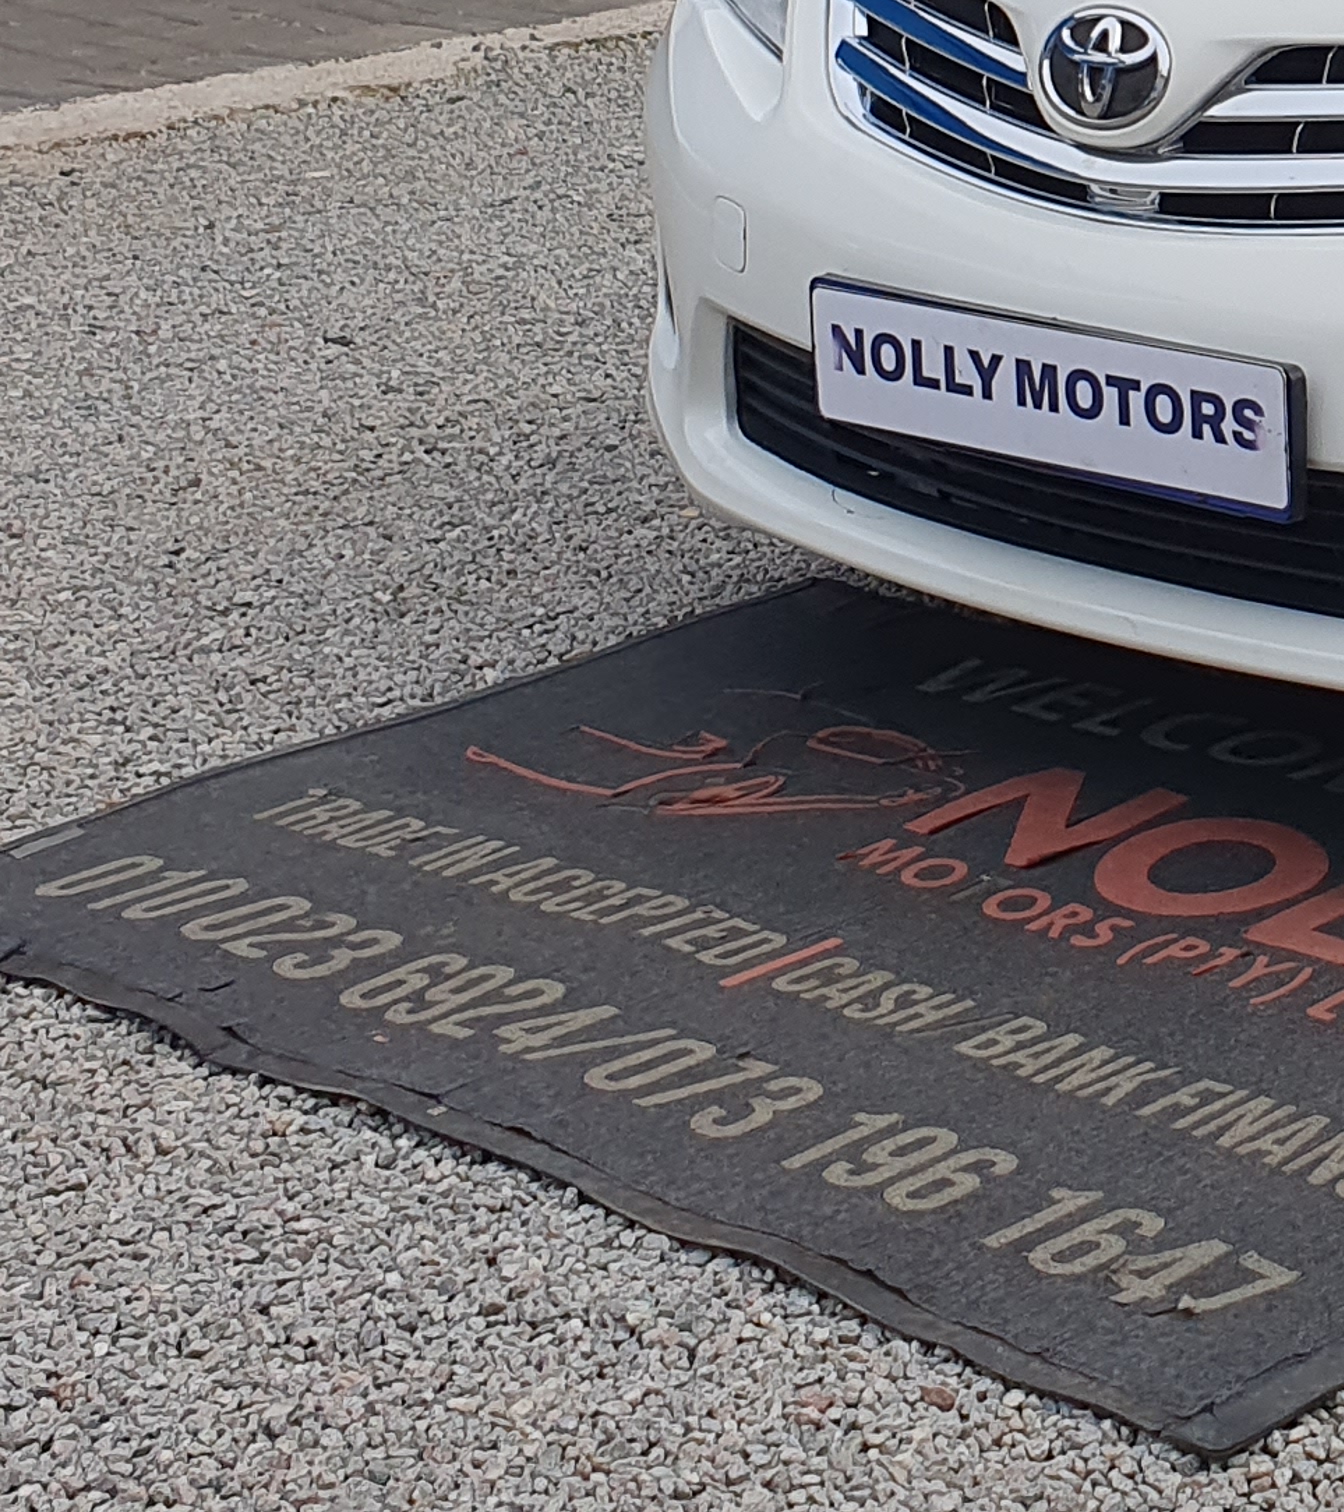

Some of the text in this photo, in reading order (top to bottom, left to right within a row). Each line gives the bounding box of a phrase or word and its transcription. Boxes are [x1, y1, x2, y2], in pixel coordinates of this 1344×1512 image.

[830, 323, 1267, 452] NOLLY MOTORS
[254, 788, 460, 858] TRADE
[408, 835, 521, 877] IN
[1116, 933, 1313, 1005] (PTY)
[781, 1111, 1019, 1212] 196
[980, 1186, 1301, 1314] 1647
